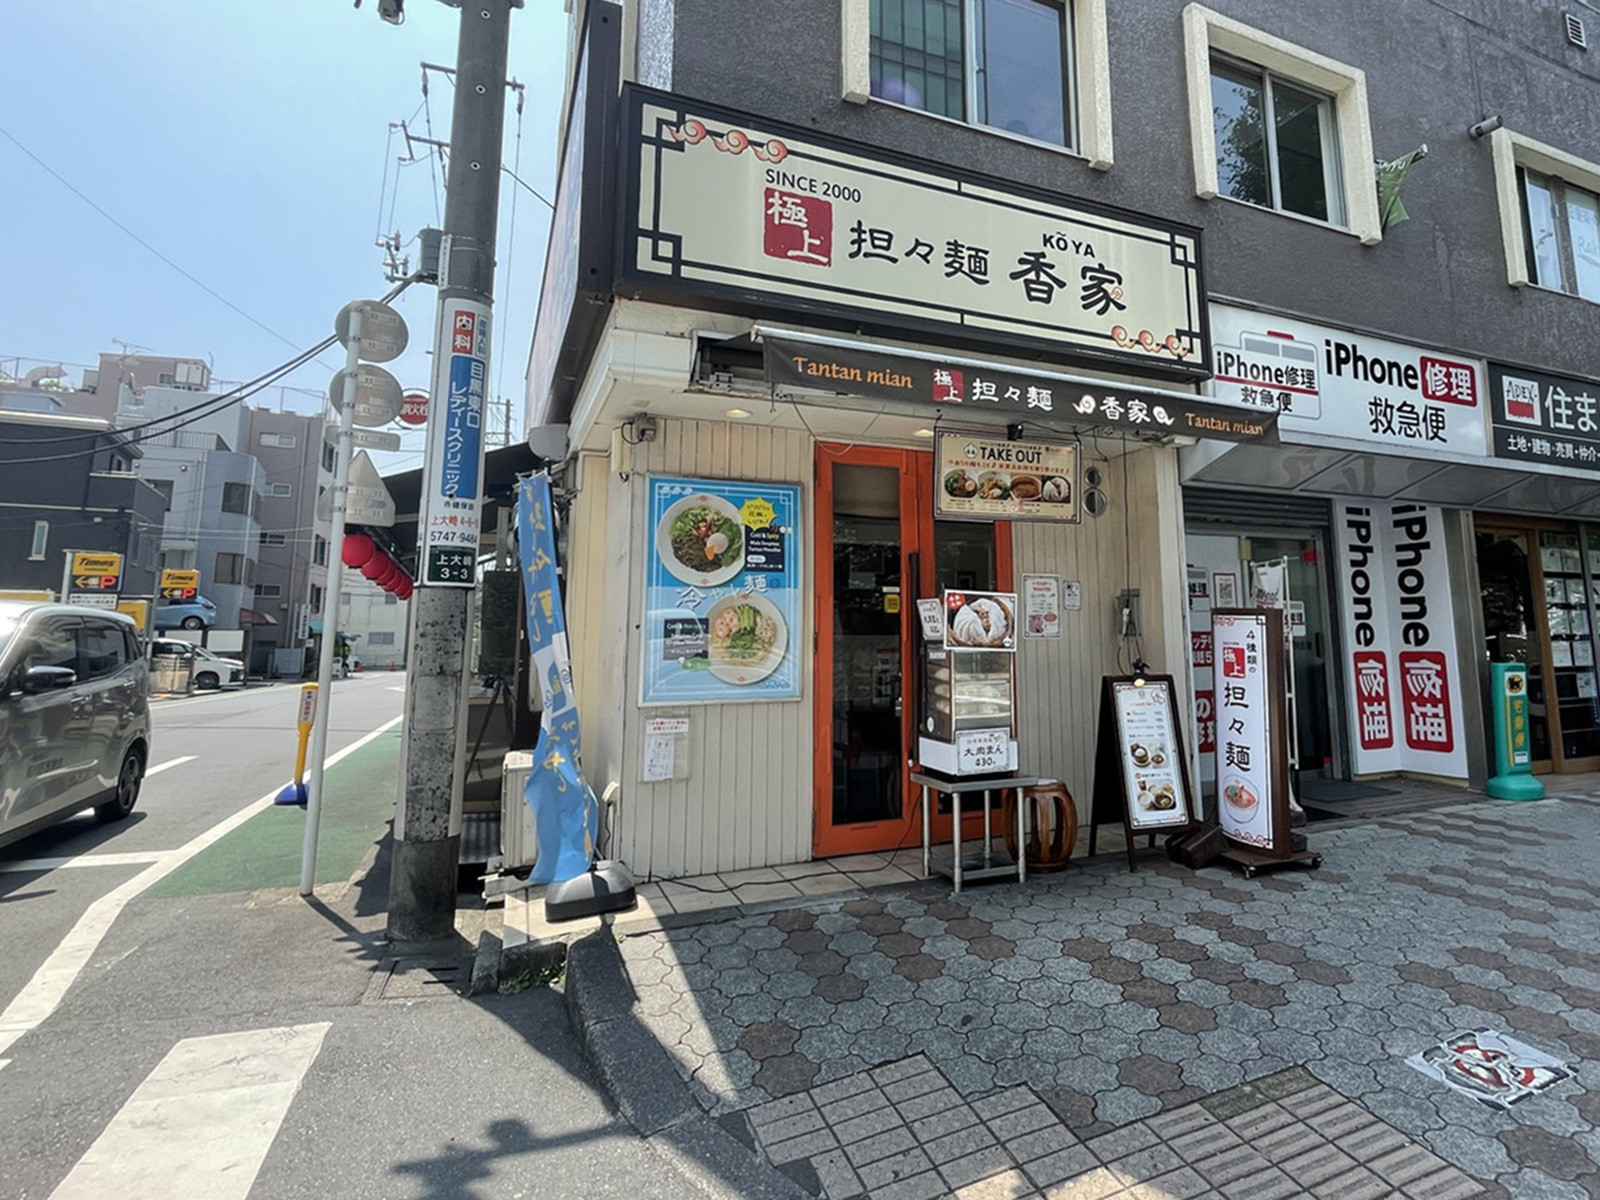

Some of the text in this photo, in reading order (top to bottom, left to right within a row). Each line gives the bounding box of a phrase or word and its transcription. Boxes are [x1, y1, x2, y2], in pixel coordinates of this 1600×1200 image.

[765, 169, 862, 203] SINCE 2000
[767, 191, 1126, 316] 極上 担々麺 香家
[454, 315, 472, 350] 内科
[792, 356, 914, 389] Tantan mian
[1324, 338, 1419, 390] iPhone
[1425, 361, 1473, 401] 修理
[933, 368, 1151, 423] 極上 担々麺 香家
[1240, 386, 1293, 413] 救急便
[1185, 412, 1265, 436] Tantan mian
[1368, 395, 1447, 443] 救急便
[980, 446, 1012, 462] TAKE
[1015, 450, 1042, 464] OUT
[431, 515, 458, 527] 上大崎
[436, 554, 472, 565] 上大崎
[440, 568, 468, 579] 3-3
[1345, 506, 1375, 647] iPhone
[1391, 504, 1431, 647] iPhone
[1357, 658, 1390, 741] 修理
[1404, 658, 1448, 742] 修理
[1223, 682, 1251, 772] 担々麺
